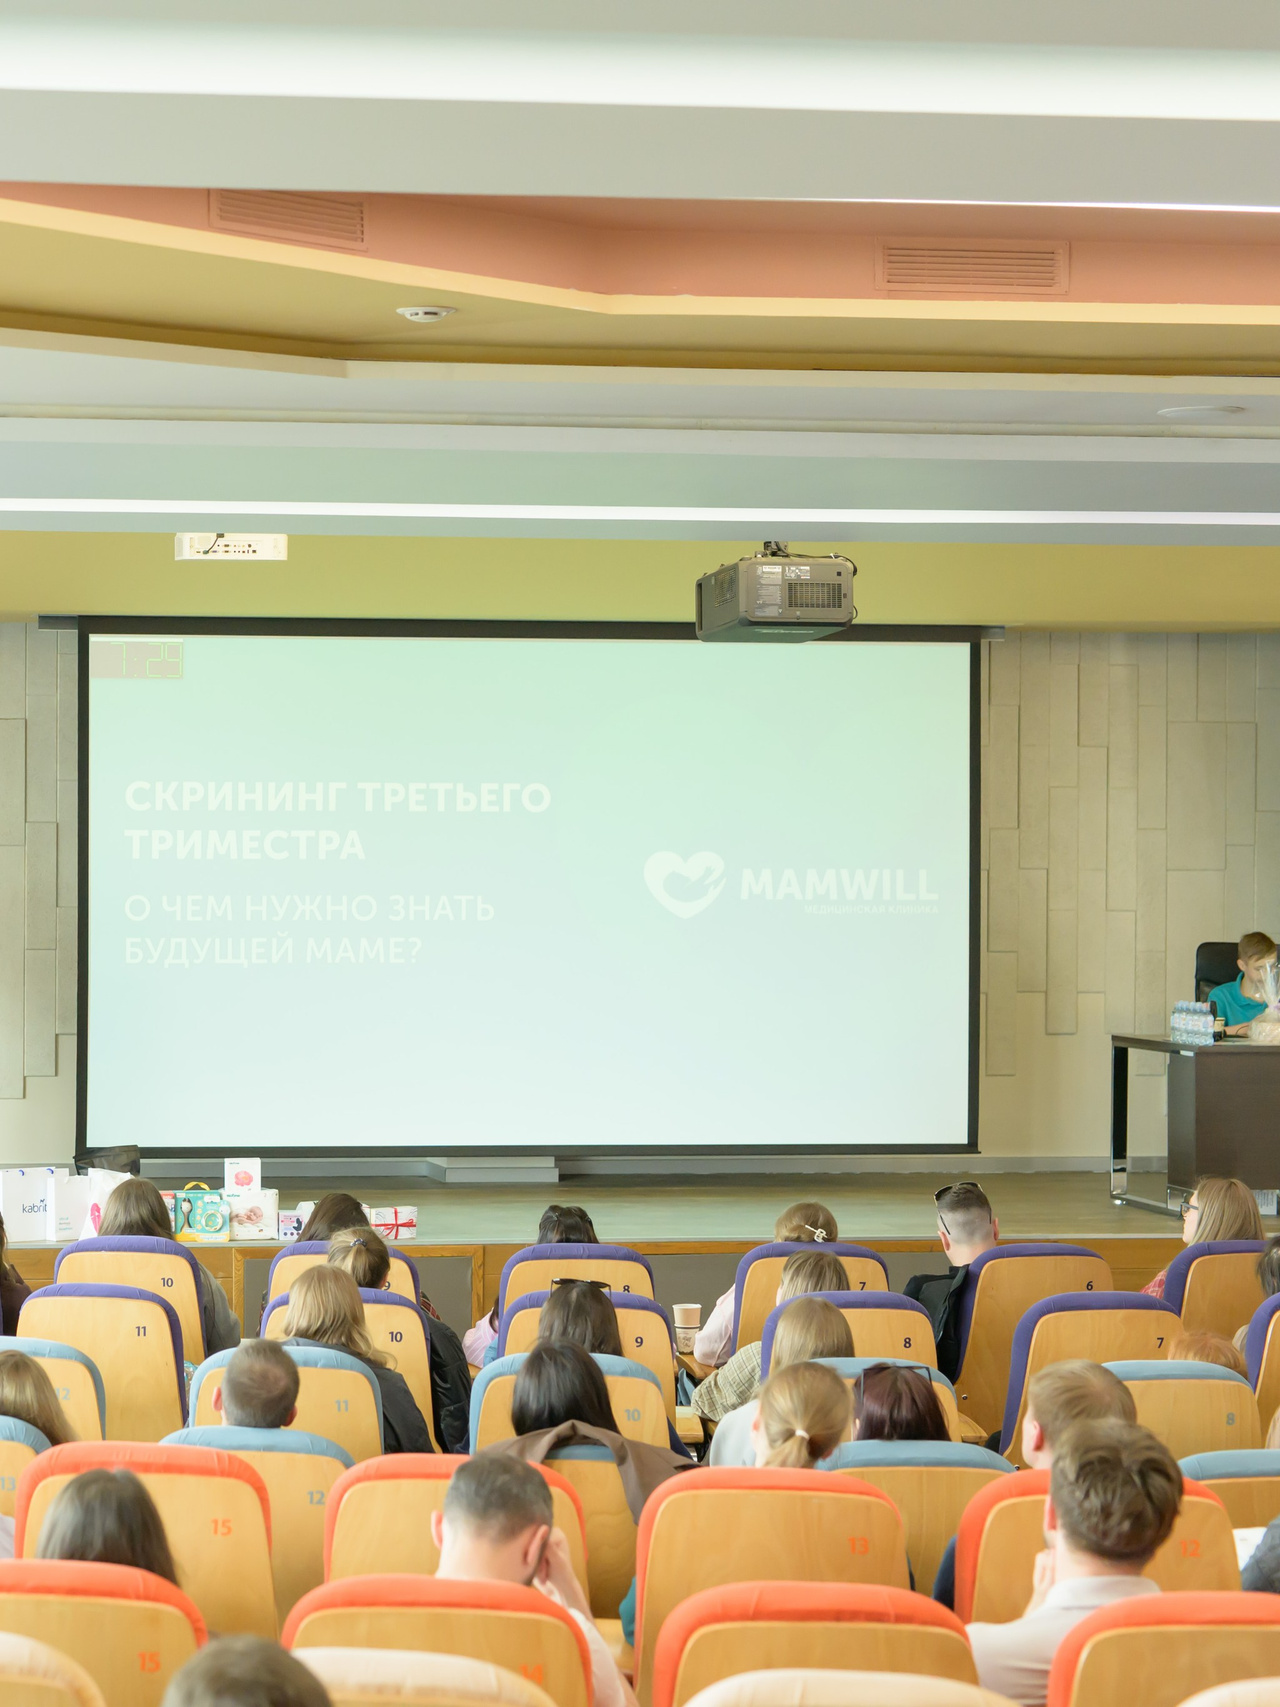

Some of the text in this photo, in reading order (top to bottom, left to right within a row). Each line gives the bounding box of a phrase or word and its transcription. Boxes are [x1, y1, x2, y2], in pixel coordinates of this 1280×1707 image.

[124, 781, 552, 814] СКРИНИНГ ТРЕТЬЕГО
[124, 829, 366, 861] ТРИМЕСТРА
[741, 868, 939, 900] MAMWILL
[124, 895, 495, 922] О ЧЕМ НУЖНО ЗНАТЬ
[805, 905, 939, 915] МЕДИЦИНСКАЯ КЛИНИКА
[124, 931, 422, 969] БУДУЩЕЙ МАМЕ?
[22, 1203, 47, 1213] kabrit
[161, 1277, 174, 1288] 10
[622, 1285, 631, 1293] 8
[859, 1282, 867, 1291] 7
[1086, 1281, 1094, 1291] 6
[135, 1326, 147, 1337] 11
[388, 1331, 403, 1343] 10
[635, 1336, 644, 1348] 9
[903, 1337, 912, 1348] 8
[1156, 1337, 1165, 1349] 7
[334, 1399, 349, 1412] 11
[624, 1408, 641, 1421] 10
[1225, 1411, 1235, 1426] 8
[0, 1476, 16, 1491] 13
[307, 1490, 325, 1505] 12
[210, 1518, 232, 1537] 15
[848, 1537, 869, 1555] 13
[1180, 1539, 1200, 1557] 12
[137, 1652, 161, 1673] 15
